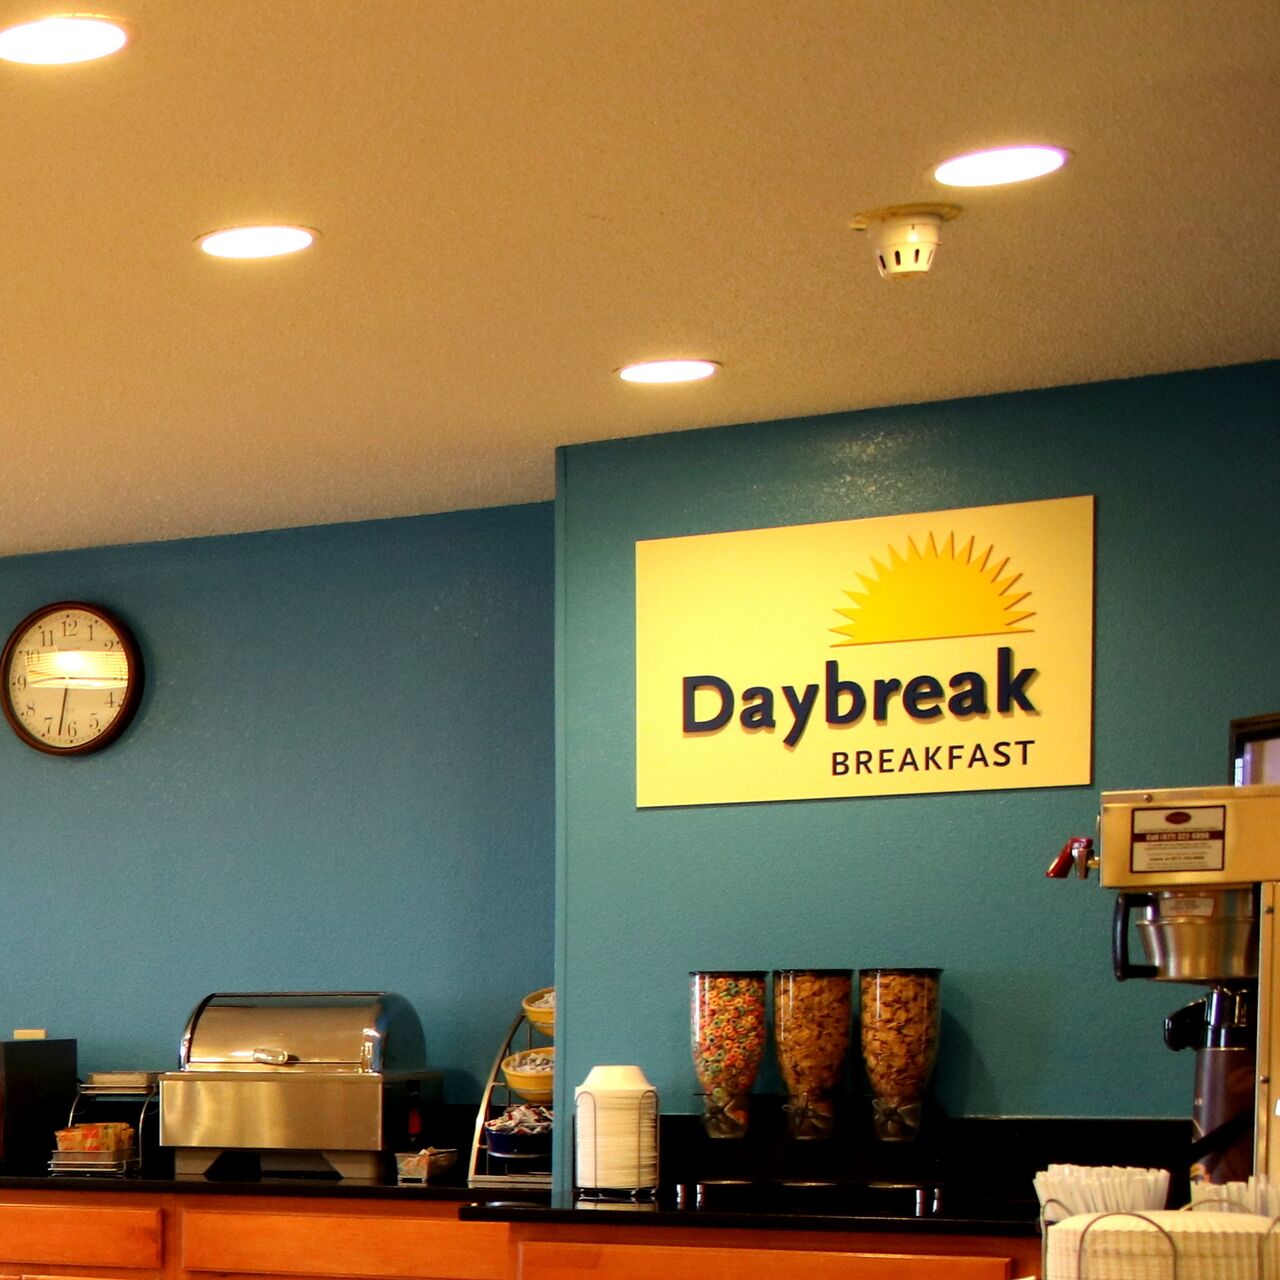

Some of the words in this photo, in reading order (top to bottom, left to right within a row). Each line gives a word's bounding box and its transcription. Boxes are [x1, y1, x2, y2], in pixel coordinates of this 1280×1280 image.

[61, 620, 78, 637] 12
[88, 624, 94, 641] 1
[40, 630, 54, 647] 11
[104, 640, 114, 656] 2
[17, 675, 27, 691] 9
[104, 691, 115, 708] 4
[682, 646, 1039, 747] Daybreak
[26, 703, 36, 717] 8
[44, 717, 53, 735] 7
[67, 721, 77, 737] 6
[89, 713, 99, 729] 5
[831, 740, 1036, 776] BREAKFAST
